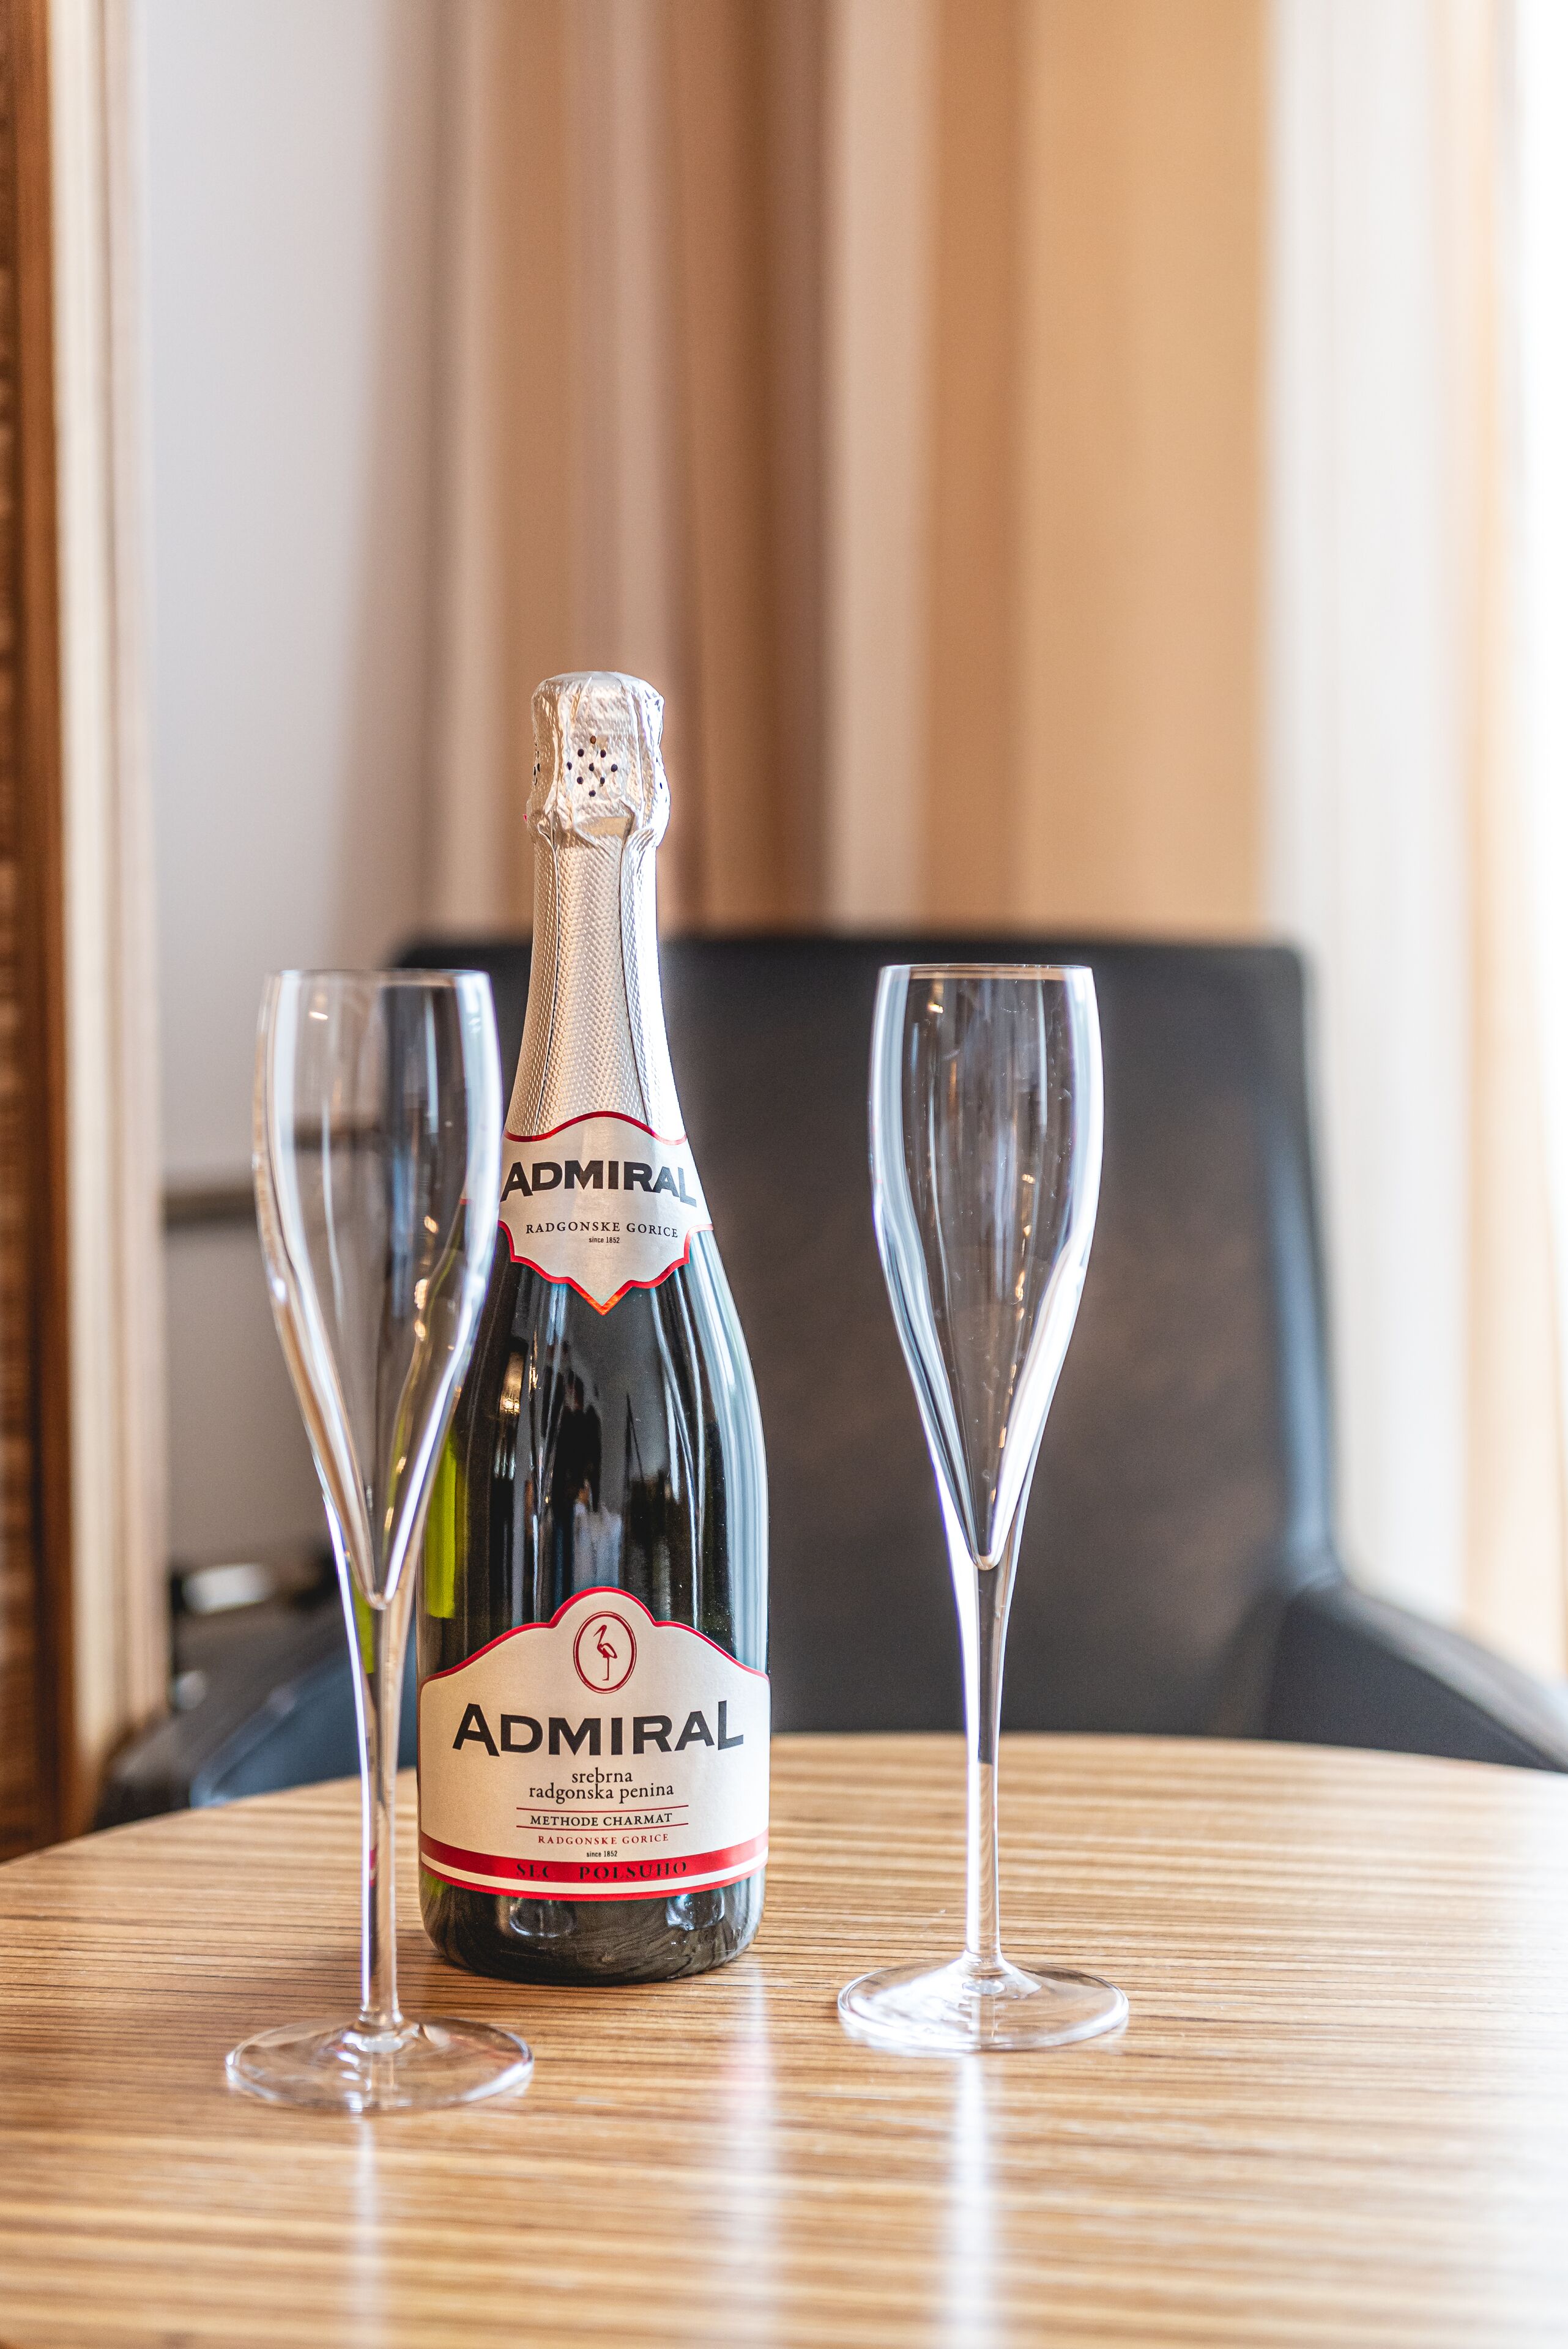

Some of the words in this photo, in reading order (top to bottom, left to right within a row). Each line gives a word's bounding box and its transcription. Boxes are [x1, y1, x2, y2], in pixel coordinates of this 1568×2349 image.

[500, 1160, 697, 1208] ADMIRAL
[526, 1222, 620, 1234] RADGONSKE
[626, 1223, 678, 1238] GORICE
[452, 1699, 745, 1757] ADMIRAL
[571, 1767, 634, 1783] srebrna
[529, 1783, 614, 1805] radgonska
[619, 1783, 674, 1804] penina
[530, 1815, 599, 1827] METHODE
[603, 1813, 673, 1827] CHARMAT
[538, 1835, 618, 1845] RADGONSKE
[622, 1833, 669, 1844] GORICE
